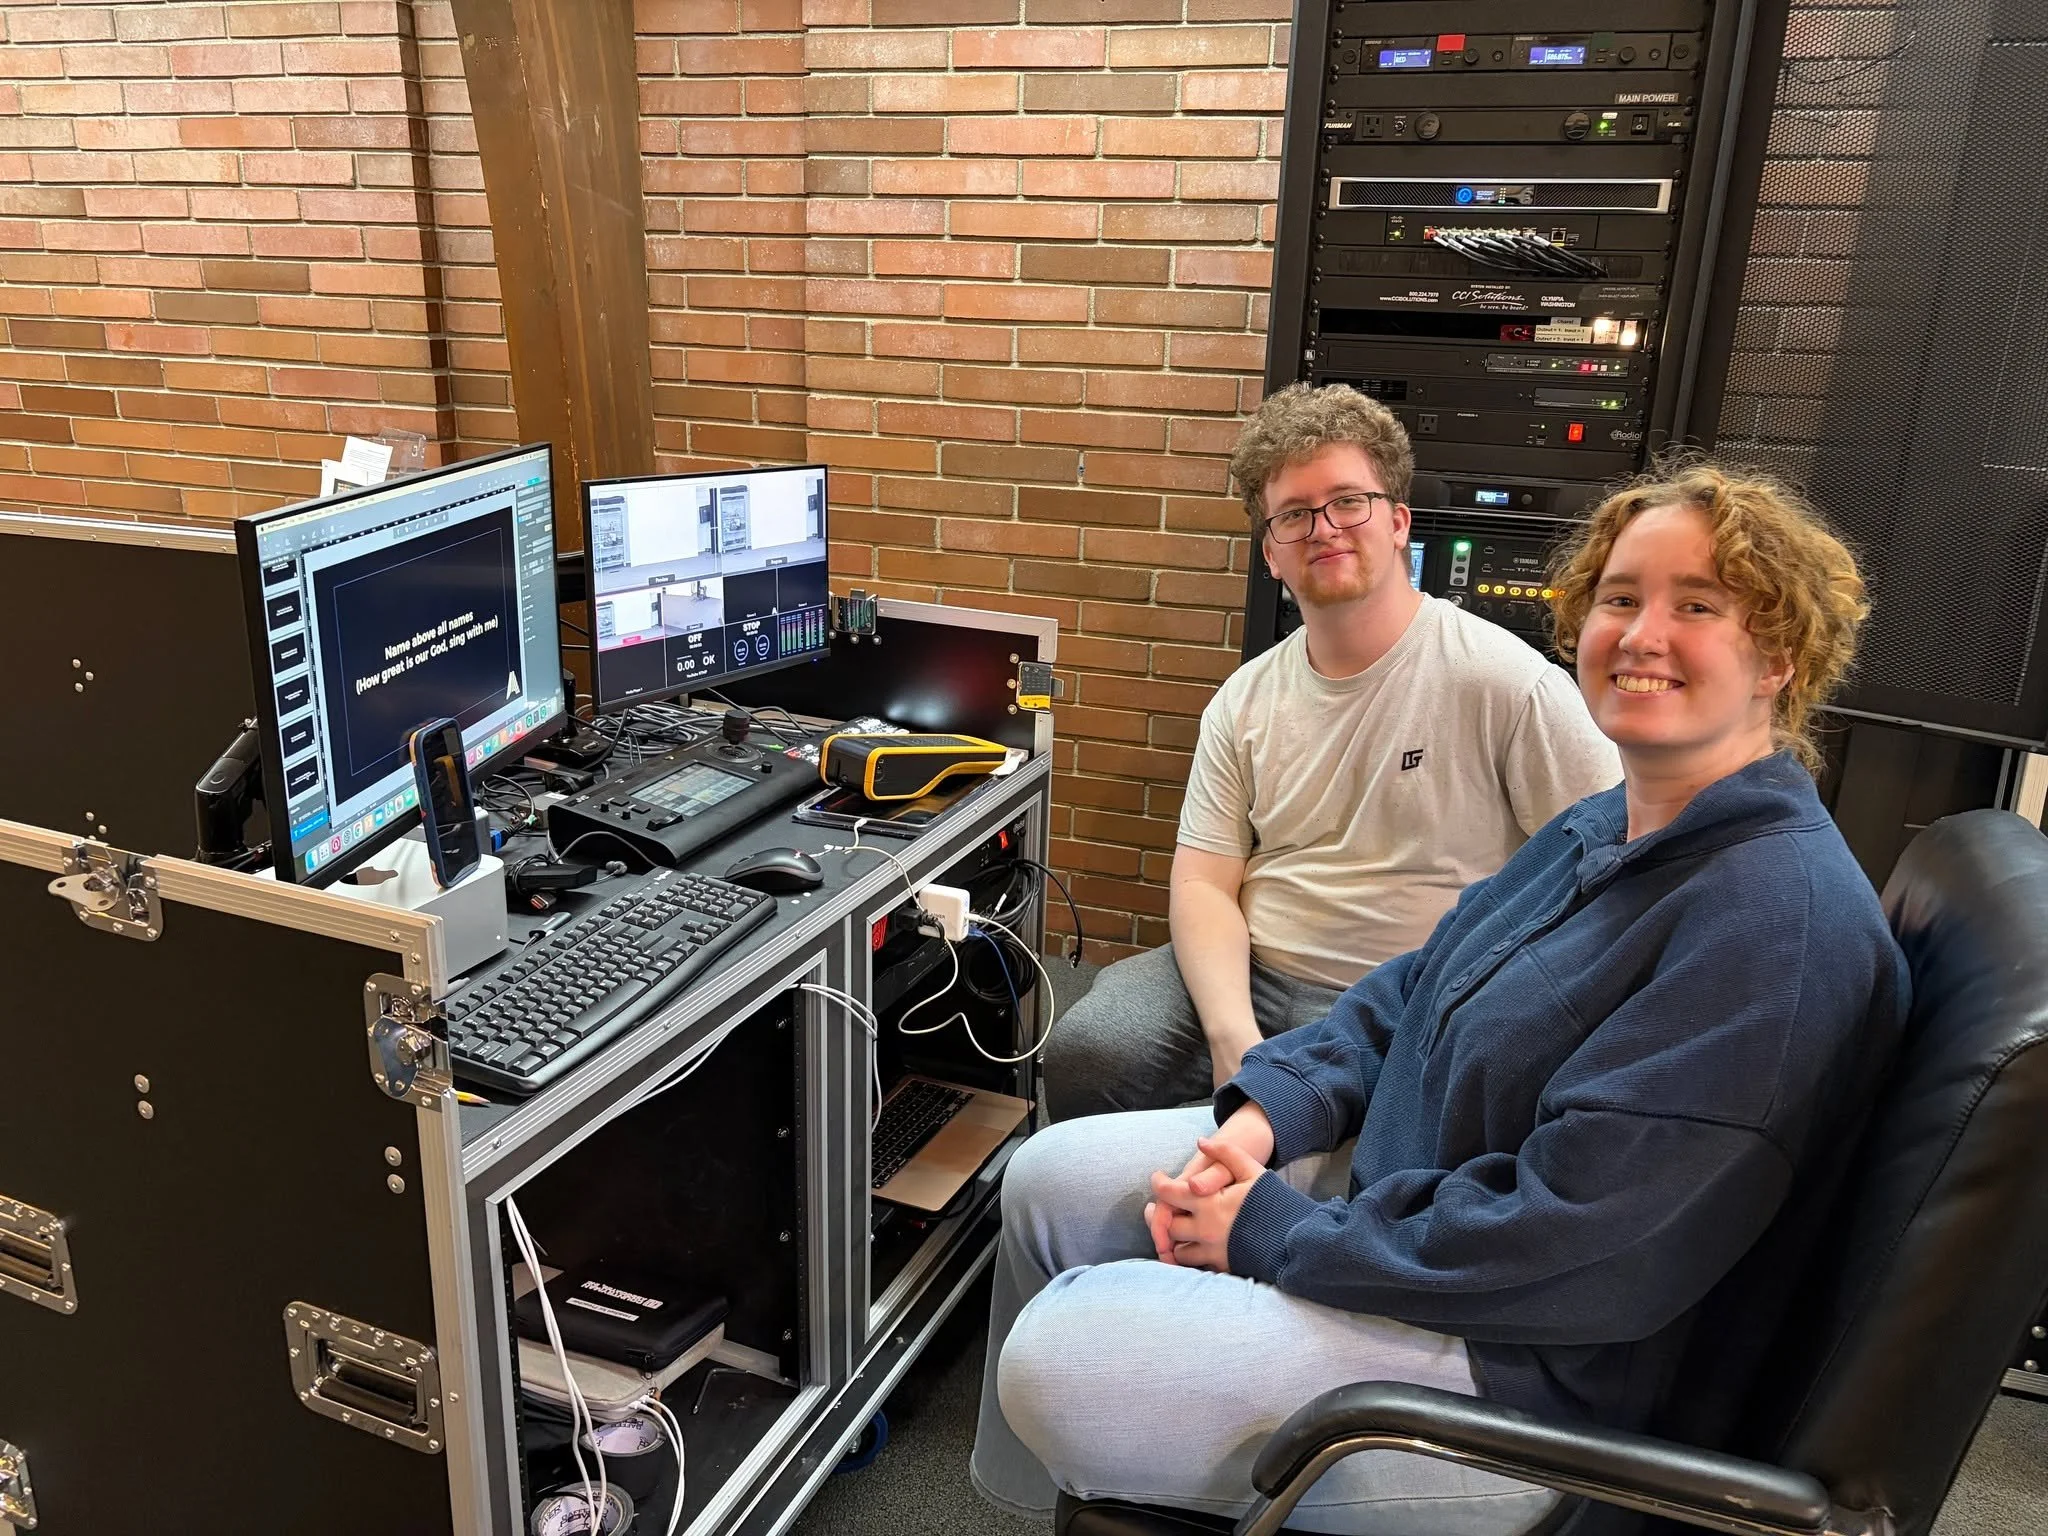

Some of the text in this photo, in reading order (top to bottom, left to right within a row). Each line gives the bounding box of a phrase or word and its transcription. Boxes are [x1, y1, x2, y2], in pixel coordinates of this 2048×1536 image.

[1619, 93, 1675, 103] MAIN POWER
[1451, 290, 1525, 301] CCI Solutions
[1616, 430, 1643, 440] Radial
[742, 620, 761, 632] STOP
[384, 611, 474, 661] Name above all names
[687, 633, 703, 644] OFF
[355, 614, 499, 696] (How great is our God, sing with me)
[702, 654, 716, 666] OK
[676, 659, 696, 672] 0.00
